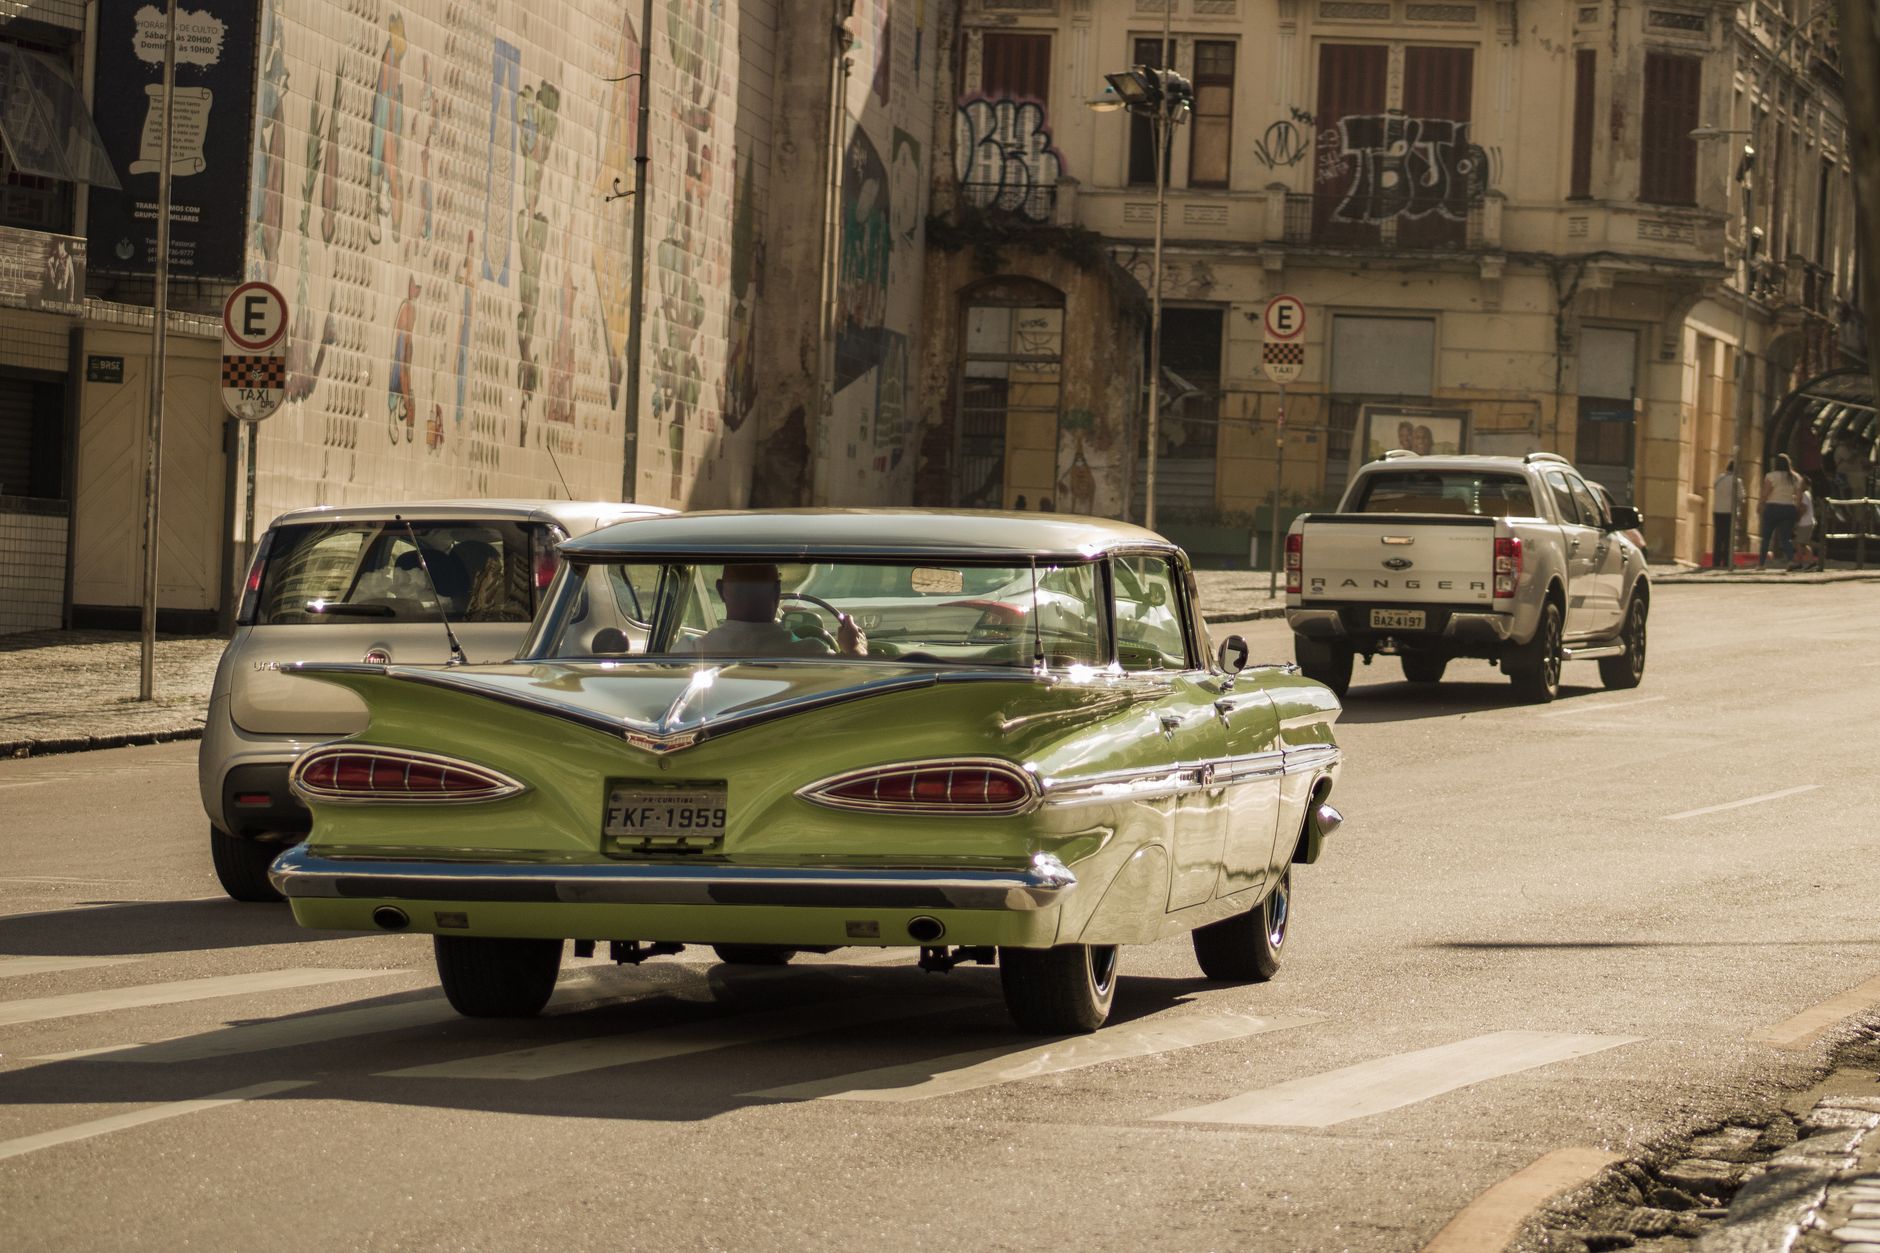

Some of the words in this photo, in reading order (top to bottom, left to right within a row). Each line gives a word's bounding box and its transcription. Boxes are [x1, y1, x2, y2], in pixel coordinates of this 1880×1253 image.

[179, 24, 190, 32] DE
[192, 25, 218, 35] CULTO
[144, 31, 169, 40] Sába
[187, 35, 212, 44] 20H00
[178, 44, 188, 52] às
[190, 45, 215, 55] 10H00
[135, 202, 184, 212] TRABALMOS
[244, 296, 268, 336] E
[1278, 305, 1293, 329] E
[1273, 366, 1294, 374] TAXI
[239, 389, 269, 401] TAXI
[1311, 578, 1486, 590] RANGER
